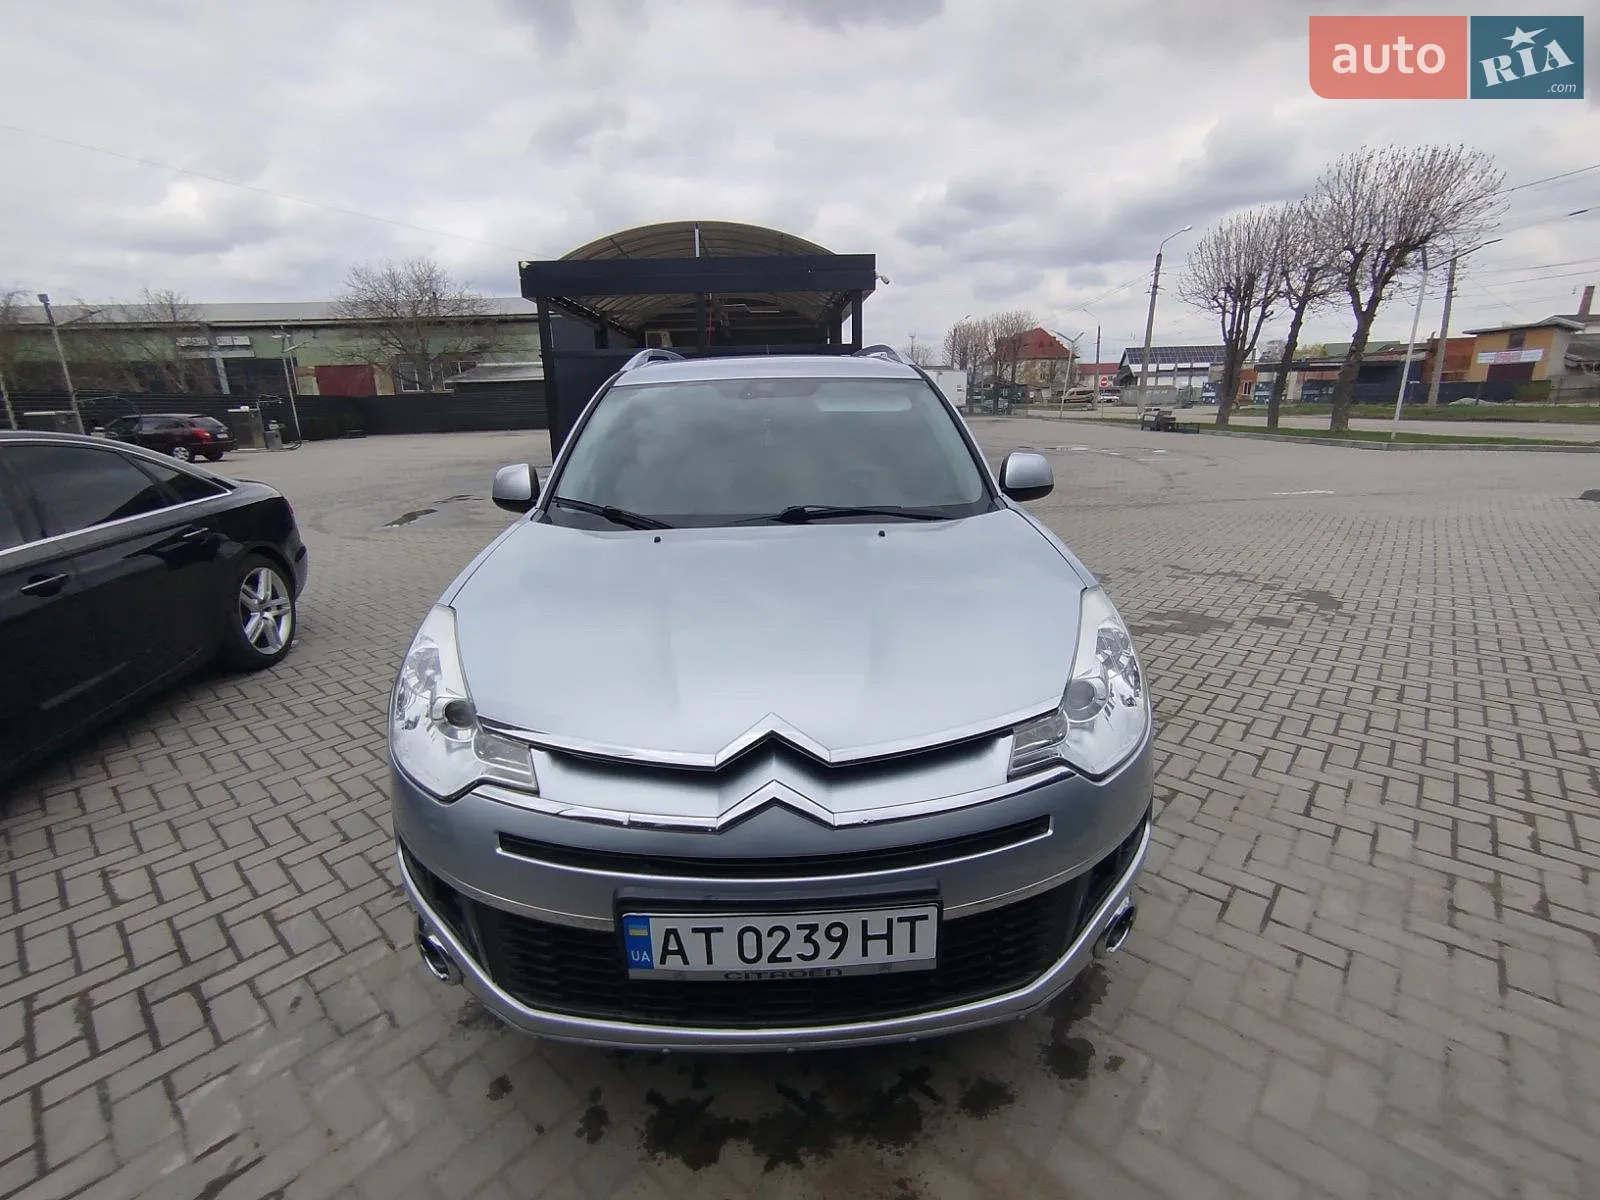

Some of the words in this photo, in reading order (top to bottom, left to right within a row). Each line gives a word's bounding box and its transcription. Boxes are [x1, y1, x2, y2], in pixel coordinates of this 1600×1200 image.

[659, 926, 724, 966] AT
[737, 921, 849, 965] 0239
[861, 914, 929, 957] HT
[631, 951, 651, 963] UA
